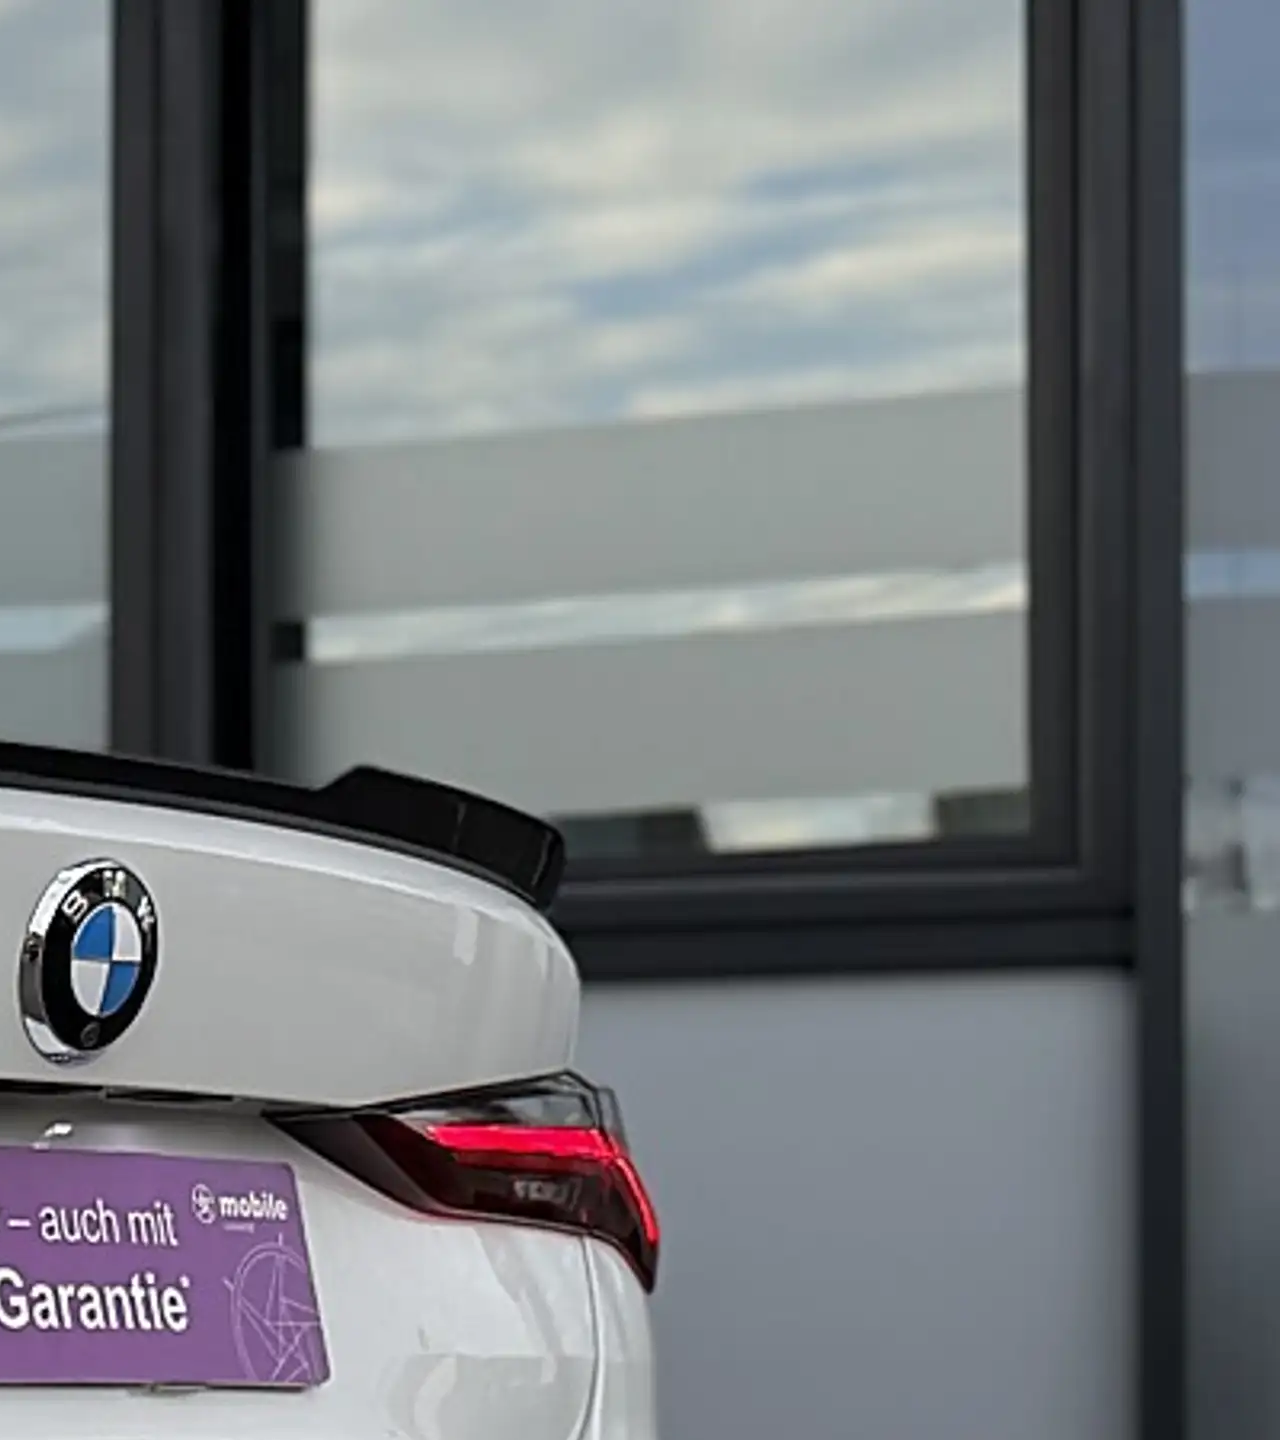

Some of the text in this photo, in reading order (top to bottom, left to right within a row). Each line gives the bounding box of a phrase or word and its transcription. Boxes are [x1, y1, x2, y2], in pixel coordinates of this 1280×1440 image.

[61, 867, 155, 932] BMW
[39, 1199, 120, 1243] auch
[128, 1201, 179, 1246] mit
[217, 1191, 288, 1220] mobile
